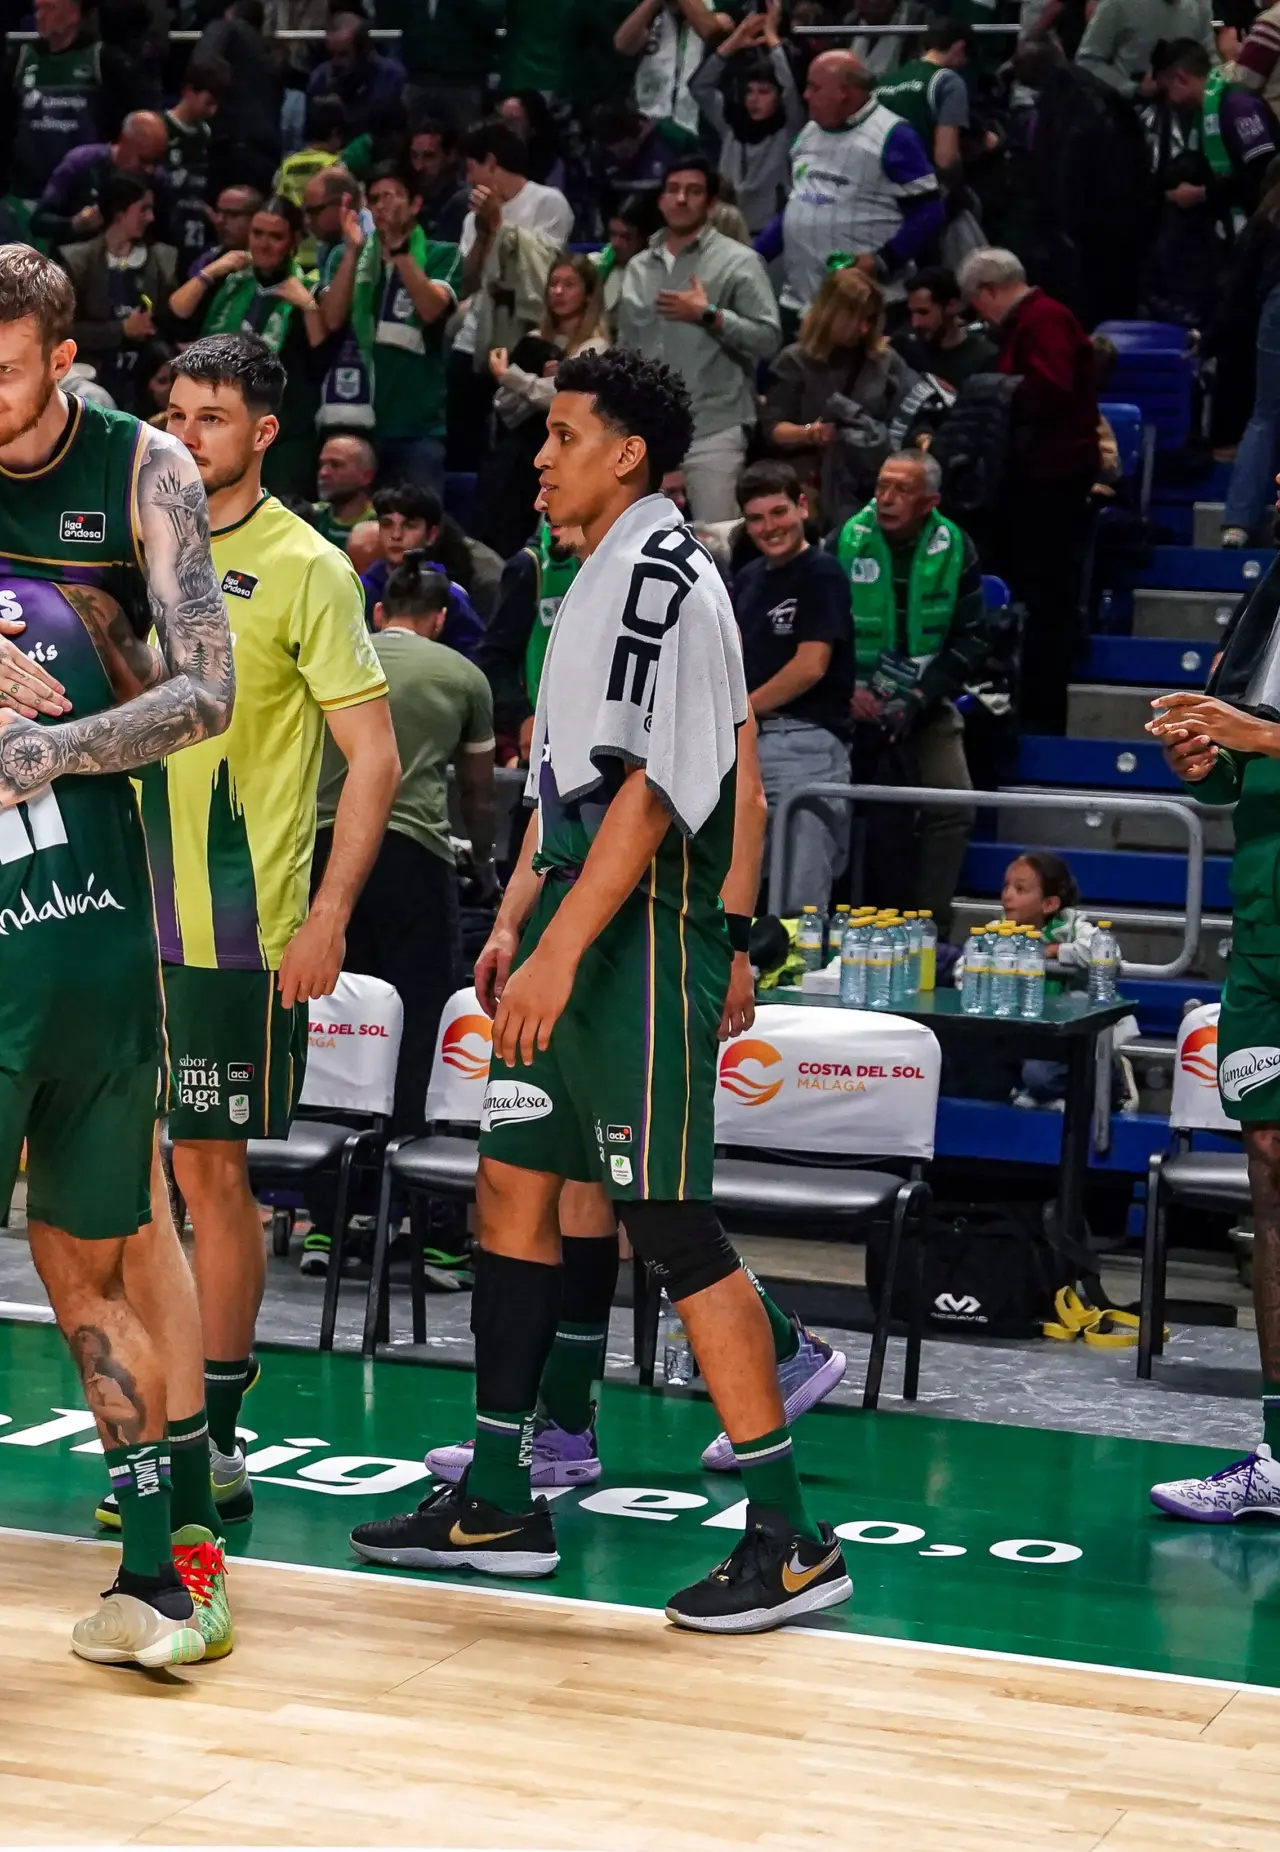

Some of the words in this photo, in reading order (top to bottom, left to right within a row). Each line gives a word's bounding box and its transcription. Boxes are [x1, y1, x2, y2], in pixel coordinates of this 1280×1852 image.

[64, 520, 82, 530] liga
[64, 529, 101, 539] endesa
[328, 1024, 355, 1035] DEL
[358, 1024, 389, 1037] SOL
[231, 1069, 249, 1080] acb
[798, 1062, 852, 1077] COSTA
[856, 1065, 887, 1078] DEL
[892, 1066, 925, 1079] SOL
[797, 1078, 867, 1092] MÁLAGA
[609, 1132, 626, 1141] acb
